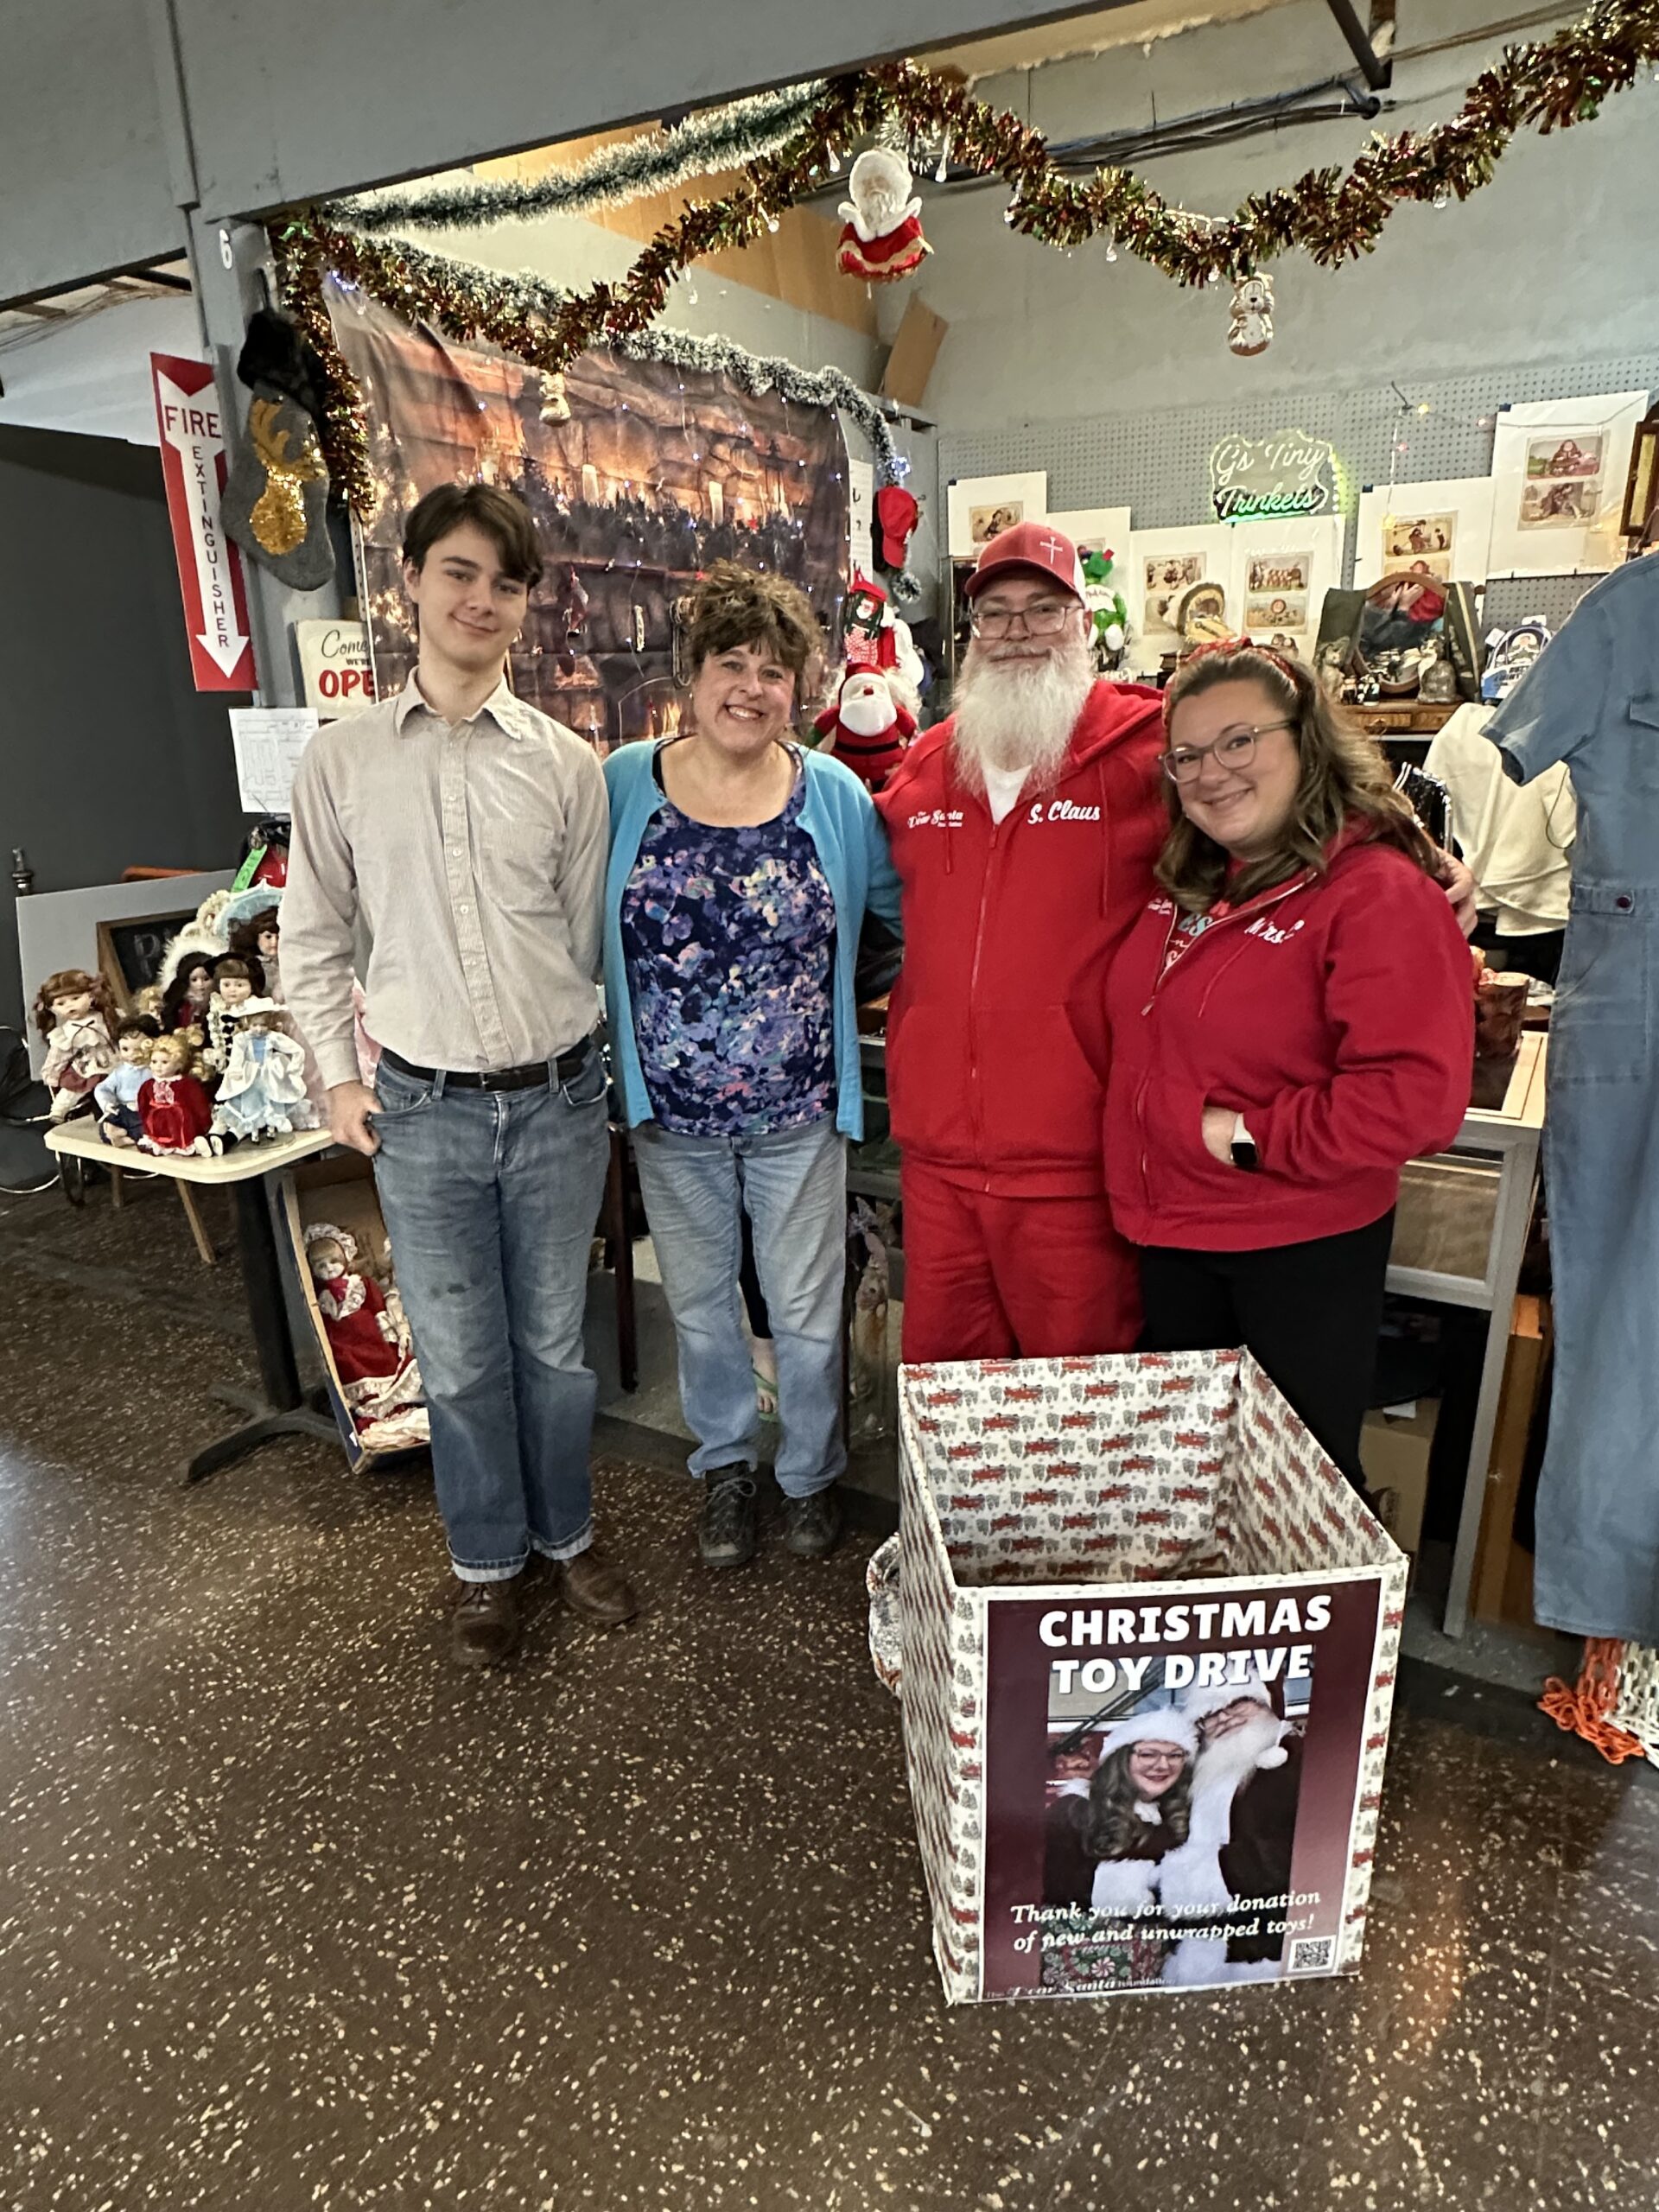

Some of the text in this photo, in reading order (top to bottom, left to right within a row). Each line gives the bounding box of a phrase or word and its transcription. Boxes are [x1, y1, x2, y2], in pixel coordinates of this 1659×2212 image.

[163, 404, 223, 440] FIRE
[1264, 442, 1325, 481] Tiny
[1216, 481, 1319, 518] Trinkets
[191, 445, 231, 649] EXTINGUISHER
[318, 668, 376, 698] OPE
[1027, 799, 1101, 825] S. Claus
[1039, 1595, 1332, 1648] CHRISTMAS
[1052, 1644, 1315, 1694] TOY DRIVE
[1010, 1890, 1321, 1924] Thank you for your donation
[1013, 1912, 1315, 1954] of new and unwrapped toys!
